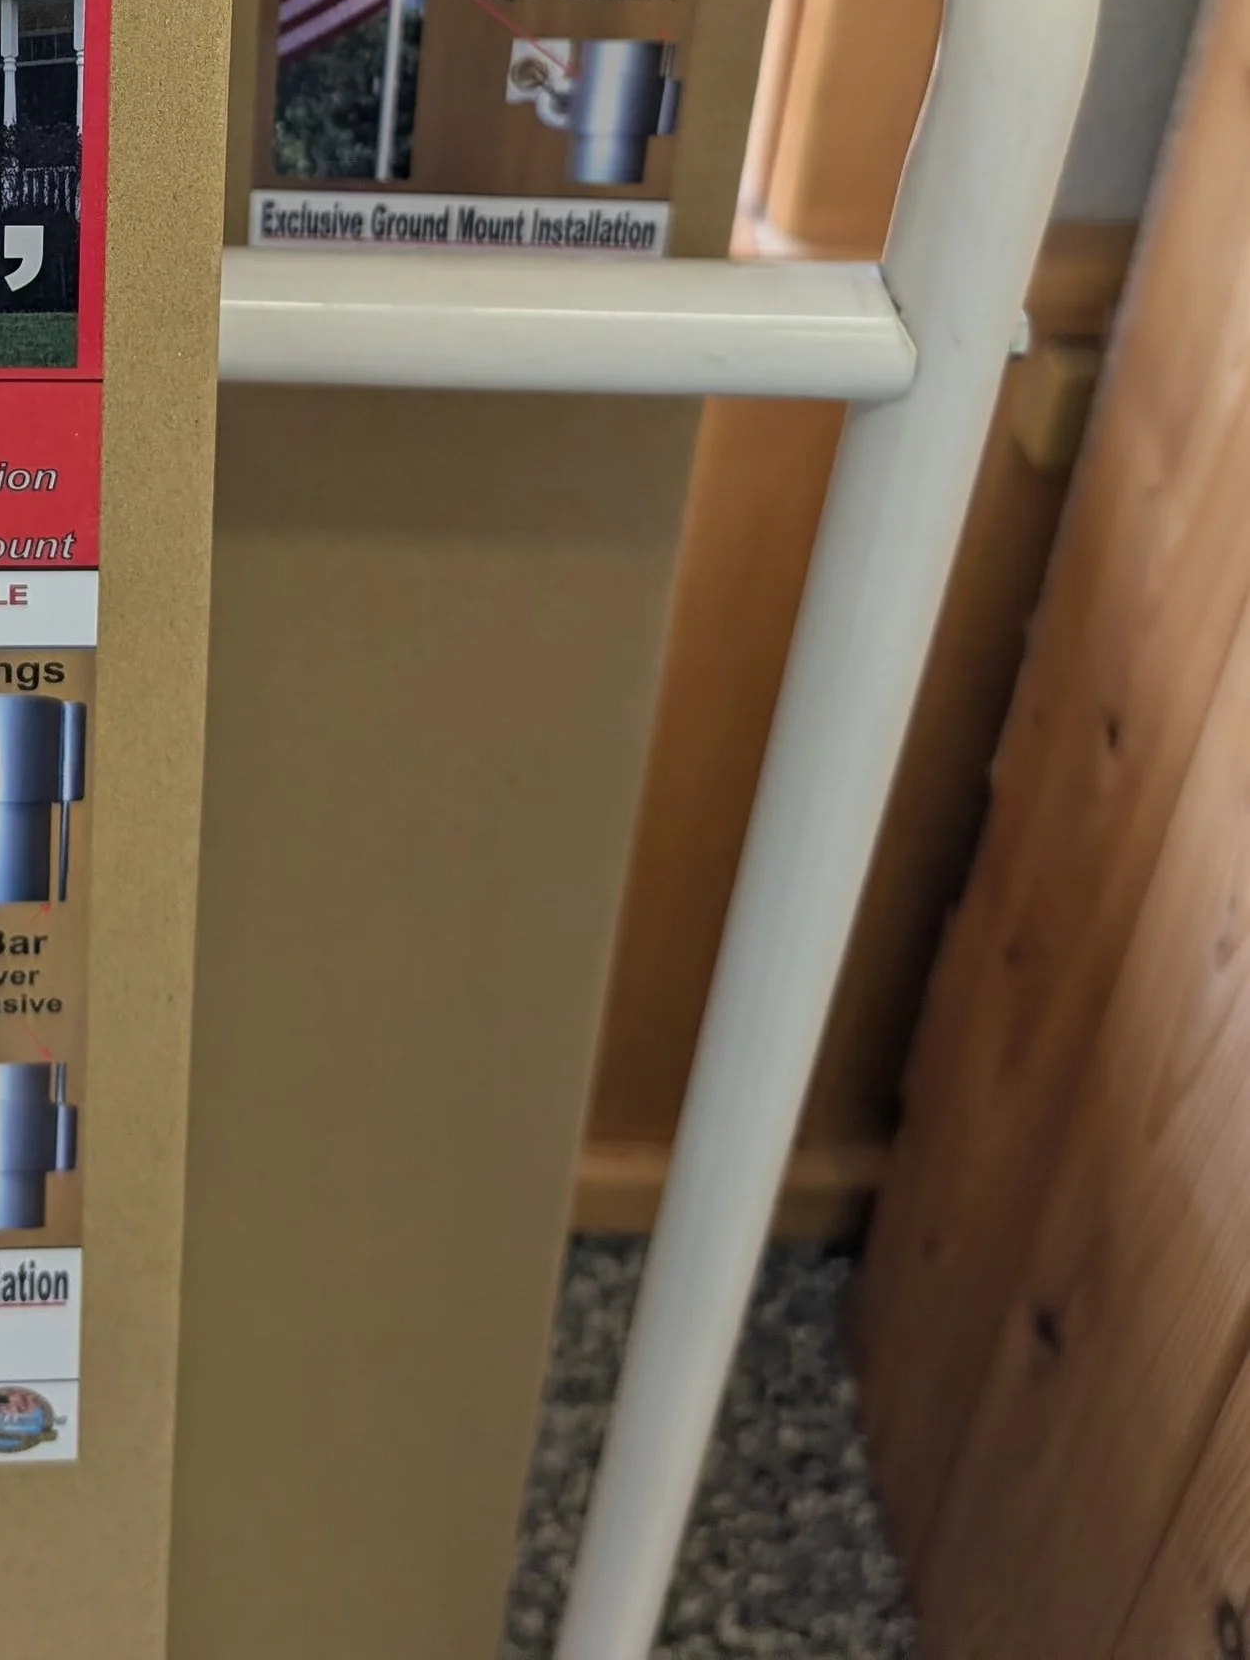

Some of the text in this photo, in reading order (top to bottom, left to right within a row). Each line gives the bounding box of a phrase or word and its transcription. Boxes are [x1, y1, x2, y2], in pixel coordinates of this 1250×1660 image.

[260, 201, 656, 249] Exclusive Ground Mount Installation
